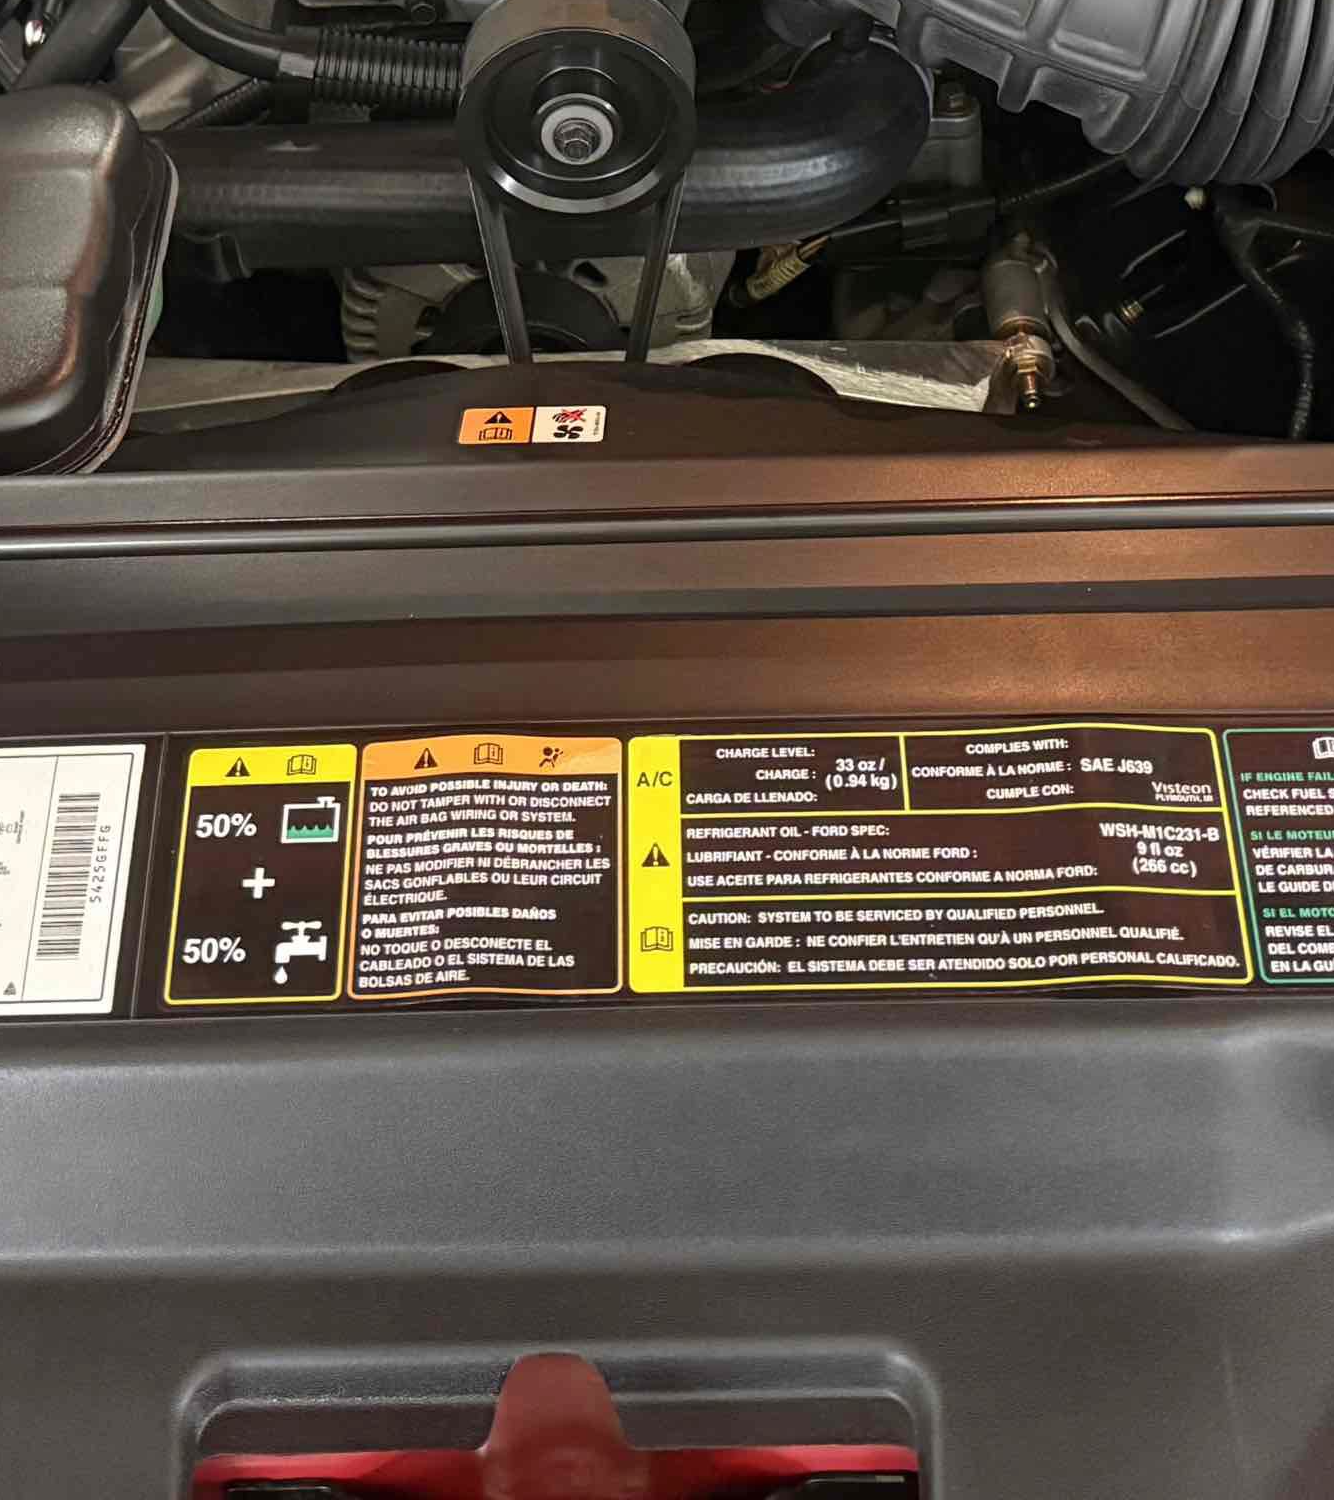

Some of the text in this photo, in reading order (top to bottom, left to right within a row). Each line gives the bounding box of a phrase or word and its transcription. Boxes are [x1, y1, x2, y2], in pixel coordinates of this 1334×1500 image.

[716, 747, 815, 758] CHARGE LEVEL:
[965, 738, 1068, 754] COMPLIES WITH:
[835, 758, 854, 772] 33
[857, 760, 876, 771] oz
[1080, 757, 1153, 774] SAE J639
[636, 770, 674, 789] A/C
[825, 773, 897, 790] (0.94 kg)
[1240, 772, 1252, 782] IF
[1256, 772, 1304, 781] ENGINE
[370, 779, 607, 797] TO AVOID POSSIBLE INJURY OR DEATH:
[986, 783, 1074, 799] CUMPLE CON:
[1151, 781, 1212, 794] Visteon
[1242, 788, 1289, 800] CHECK
[1291, 788, 1326, 799] FUEL
[369, 794, 611, 812] DO NOT TAMPER WITH OR DISCONNECT
[685, 791, 817, 804] CARGA DE LLENADO:
[368, 809, 575, 827] THE AIR BAG WIRING OR SYSTEM.
[1245, 804, 1334, 816] REFERENCED
[196, 812, 258, 838] 50%
[686, 826, 777, 839] REFRIGERANT
[779, 826, 802, 837] OIL
[811, 825, 848, 836] FORD
[850, 824, 889, 836] SPEC:
[1099, 823, 1220, 841] WSH-M1C231-B
[1136, 841, 1183, 857] 9 fl oz
[1132, 857, 1197, 878] (266 cc)
[363, 889, 447, 906] ÉLECTRIQUE.
[362, 906, 556, 924] PARA EVITAR POSIBLES DAÑOS
[688, 902, 1104, 925] CAUTION: SYSTEM TO BE SERVICED BY QUALIFIED PERSONNEL.
[361, 924, 439, 939] O MUERTES:
[182, 937, 247, 964] 50%
[358, 969, 469, 988] BOLSAS DE AIRE.
